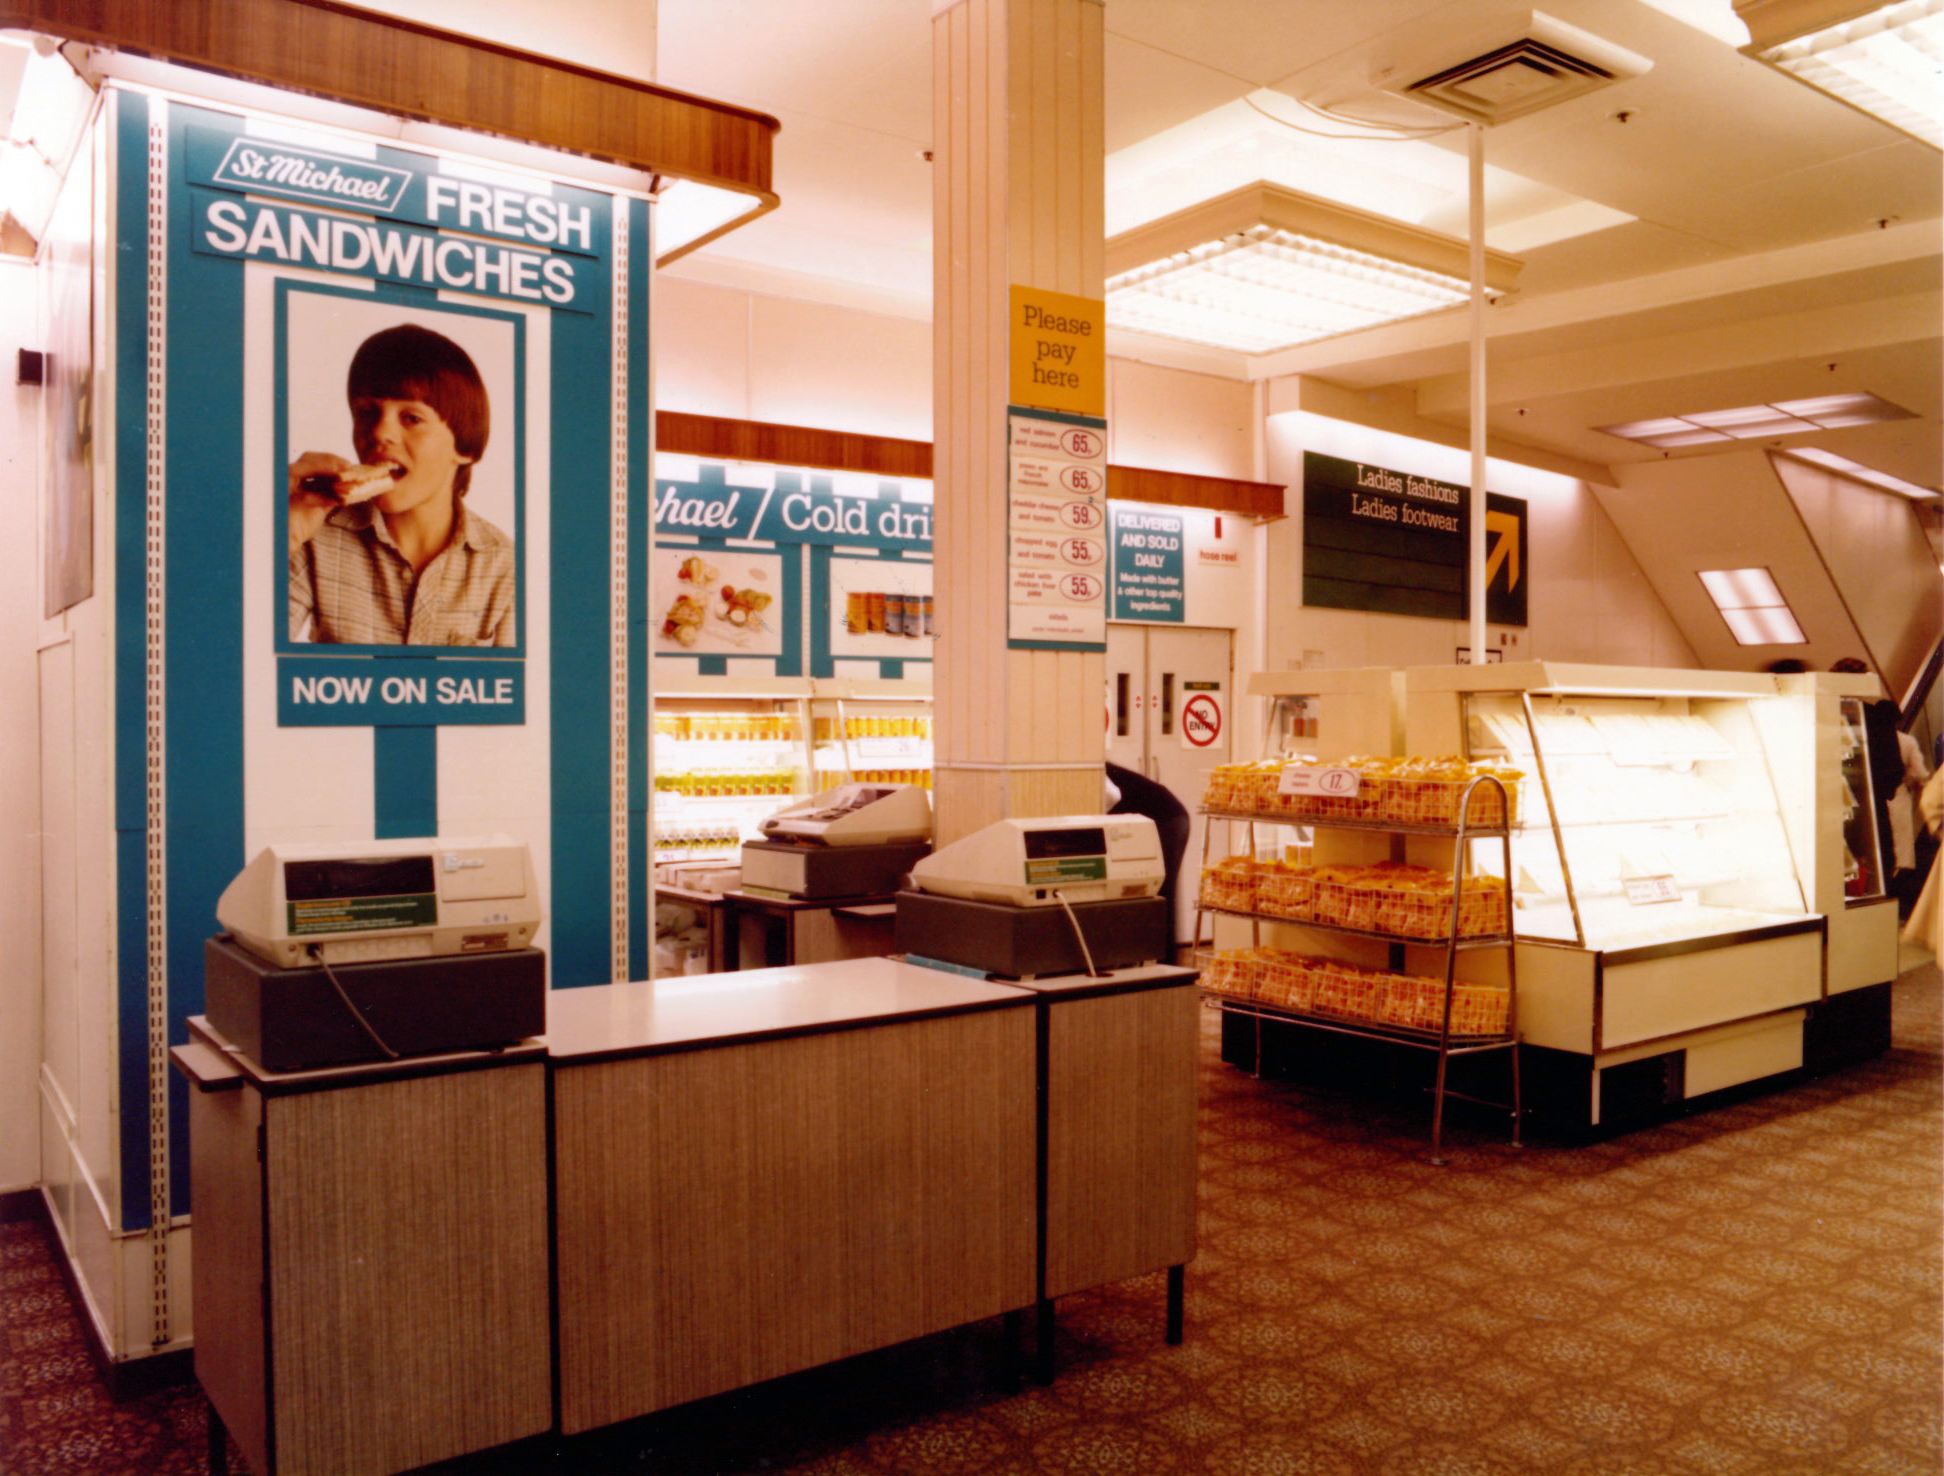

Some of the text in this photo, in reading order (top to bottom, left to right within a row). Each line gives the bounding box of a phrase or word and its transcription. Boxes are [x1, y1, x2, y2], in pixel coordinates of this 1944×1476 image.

[231, 149, 591, 250] St Michael FRESH
[204, 200, 575, 304] SANDWICHES
[1022, 304, 1092, 337] Please
[1035, 339, 1077, 366] pay
[1031, 361, 1080, 389] here
[1356, 464, 1460, 504] Ladies fashions
[654, 485, 933, 540] hael Cold dri
[1117, 514, 1181, 533] DELIVERED
[1351, 493, 1460, 533] Ladies footwear
[1121, 532, 1179, 551] AND SOLD
[1134, 553, 1165, 569] DAILY
[292, 677, 514, 705] NOW ON SALE
